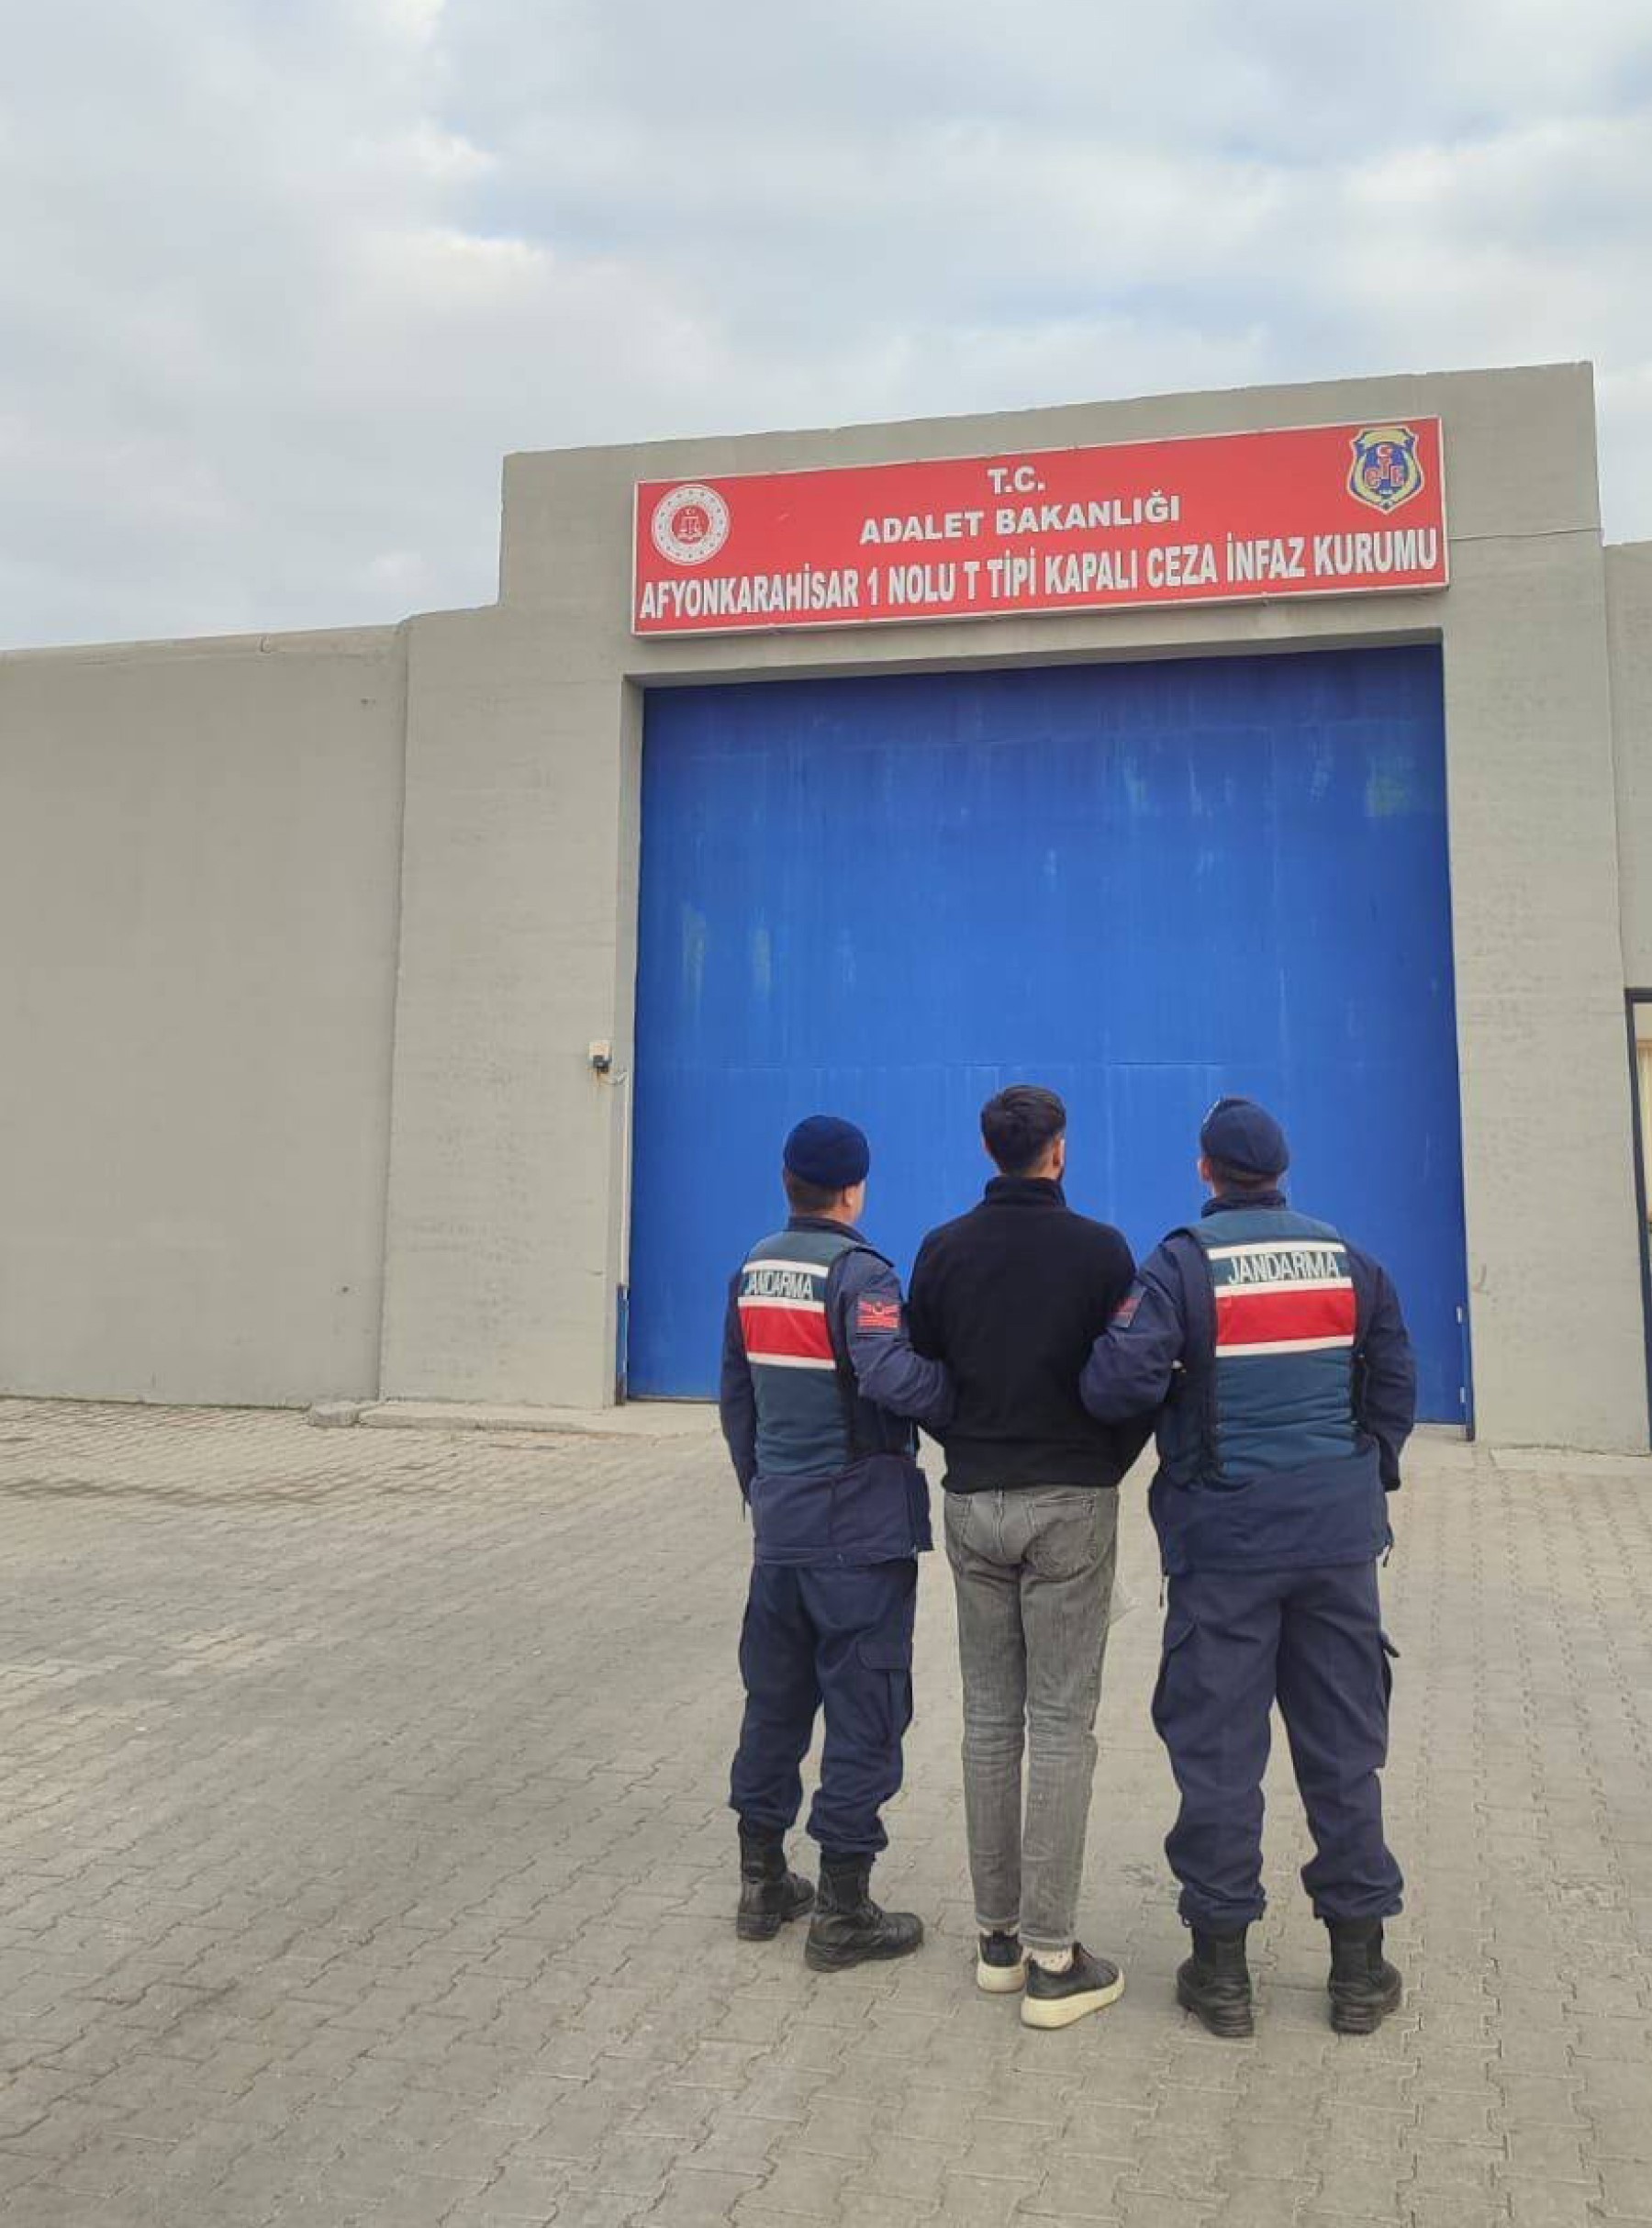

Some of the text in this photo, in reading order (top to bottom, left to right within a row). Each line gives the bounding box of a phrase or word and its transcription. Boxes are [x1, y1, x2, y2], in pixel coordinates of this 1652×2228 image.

[988, 466, 1045, 494] T.C.
[860, 489, 1180, 544] ADALET BAKANLIĞI
[640, 529, 1437, 620] AFYONKARAHİSAR 1 NOLU T TİPİ KAPALI CEZA İNFAZ KURUMU
[1229, 1252, 1339, 1283] JANDARMA
